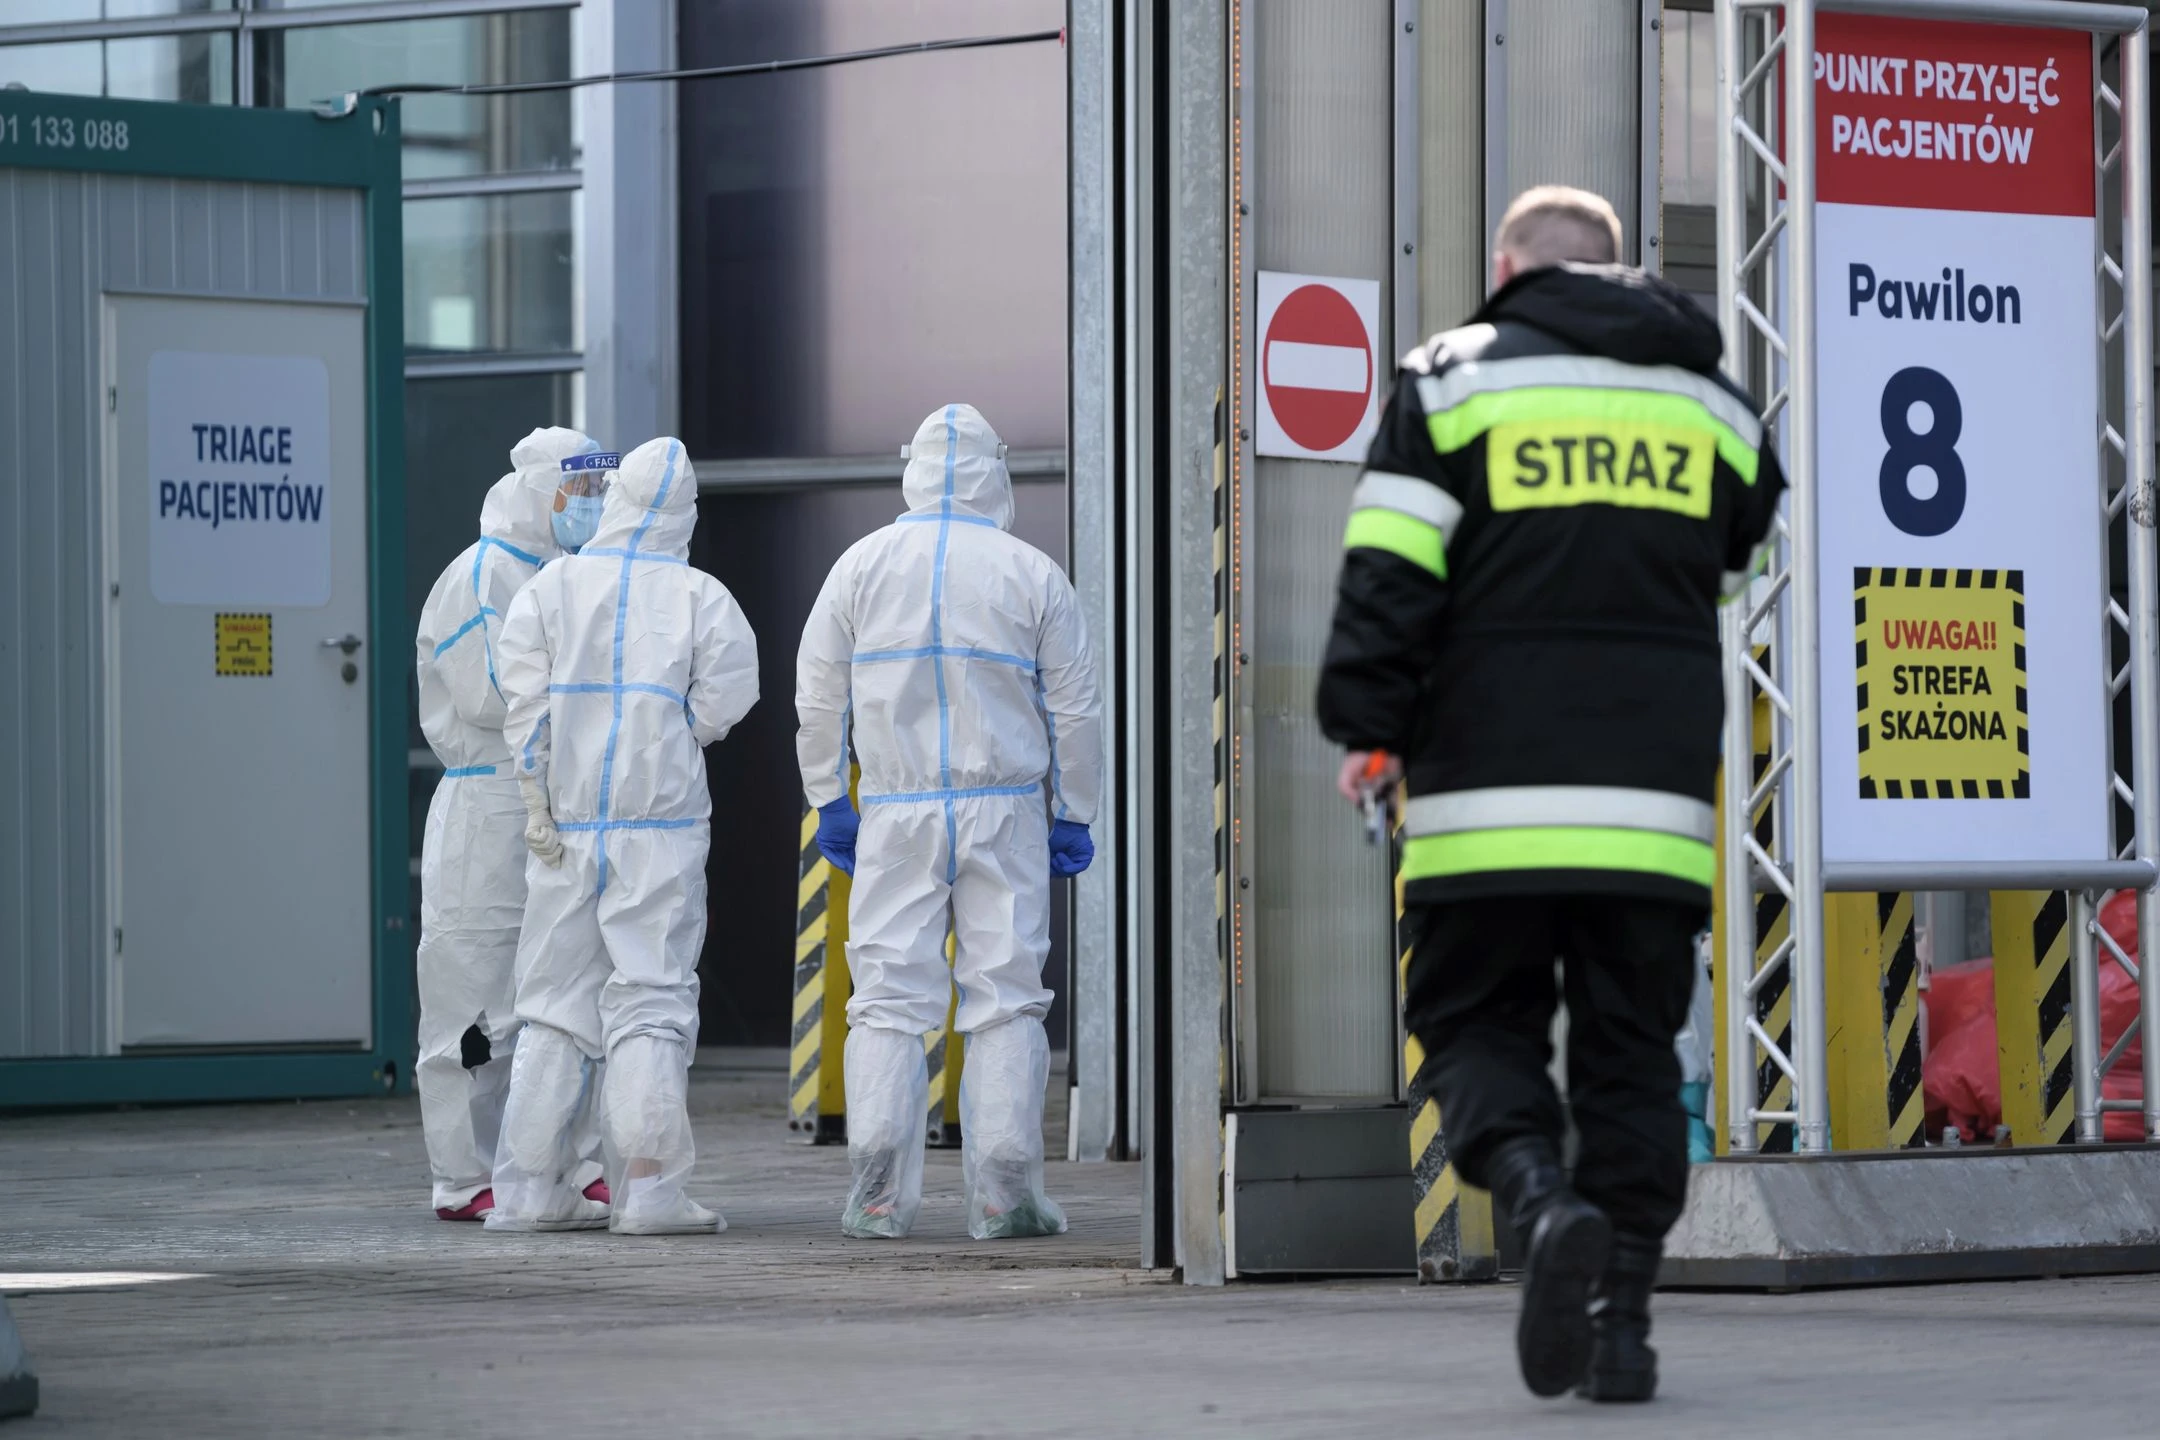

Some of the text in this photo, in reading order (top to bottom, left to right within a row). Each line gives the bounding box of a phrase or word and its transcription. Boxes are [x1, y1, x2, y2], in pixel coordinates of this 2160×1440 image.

[1914, 58, 2060, 114] PRZYJĘĆ
[31, 114, 75, 148] 133
[84, 119, 129, 150] 088
[1832, 114, 2034, 165] PACJENTÓW
[1849, 263, 2021, 324] Pawilon
[192, 423, 292, 464] TRIAGE
[595, 457, 617, 467] FACE
[1879, 366, 1966, 537] 8
[159, 473, 324, 529] PACJENTÓW
[1883, 619, 1997, 650] UWAGA!!
[1892, 664, 1992, 695] STREFA
[1880, 701, 2007, 740] SKAŻONA
